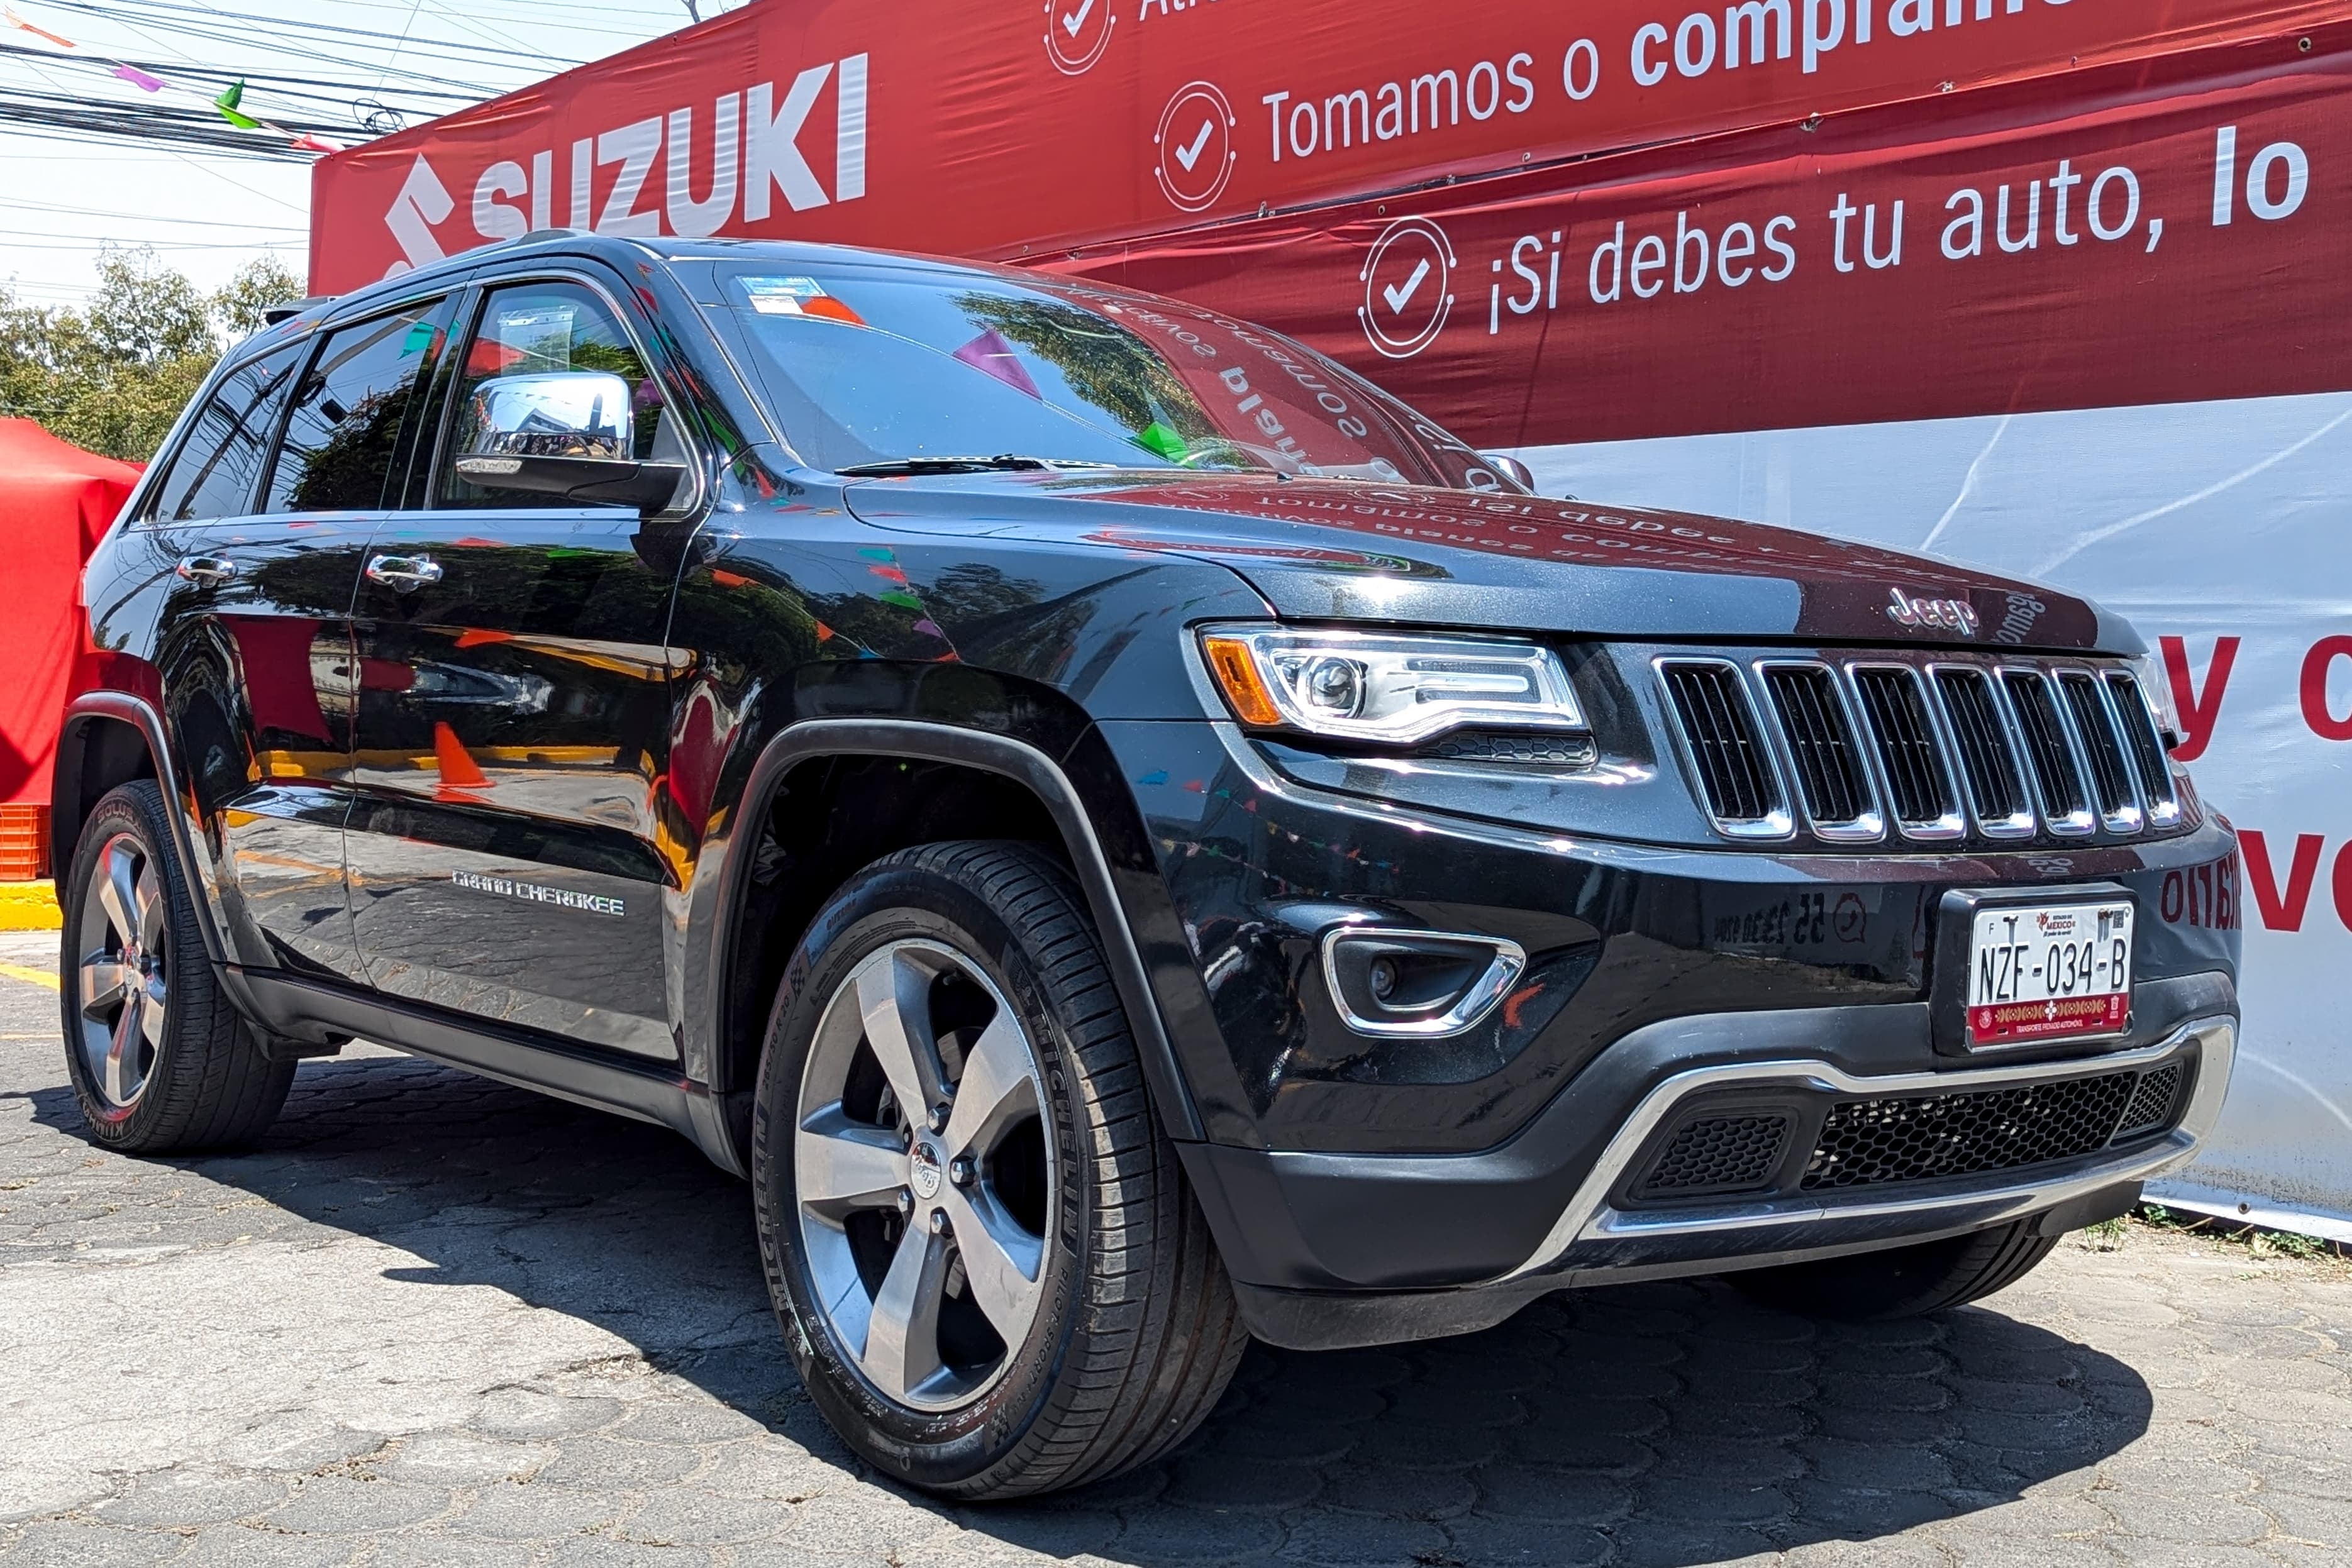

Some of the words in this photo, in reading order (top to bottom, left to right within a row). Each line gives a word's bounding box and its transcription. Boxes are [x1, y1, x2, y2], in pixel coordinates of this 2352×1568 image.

[472, 52, 868, 240] SUZUKI
[1262, 52, 1534, 162] Tomamos
[1563, 38, 1599, 101] o
[1631, 0, 2072, 79] compra
[1489, 230, 1562, 335] ¡Si
[1589, 211, 1797, 304] debes
[1829, 192, 1904, 273] tu
[1941, 159, 2163, 260] auto,
[2212, 124, 2309, 226] lo
[1887, 587, 1979, 638] Jeep
[452, 869, 512, 895] GRAND
[516, 882, 625, 916] CHEROKEE
[1979, 937, 2126, 1003] NZF-034-B
[1029, 1012, 1079, 1236] MICHELIN
[757, 1115, 788, 1311] MICHELIN
